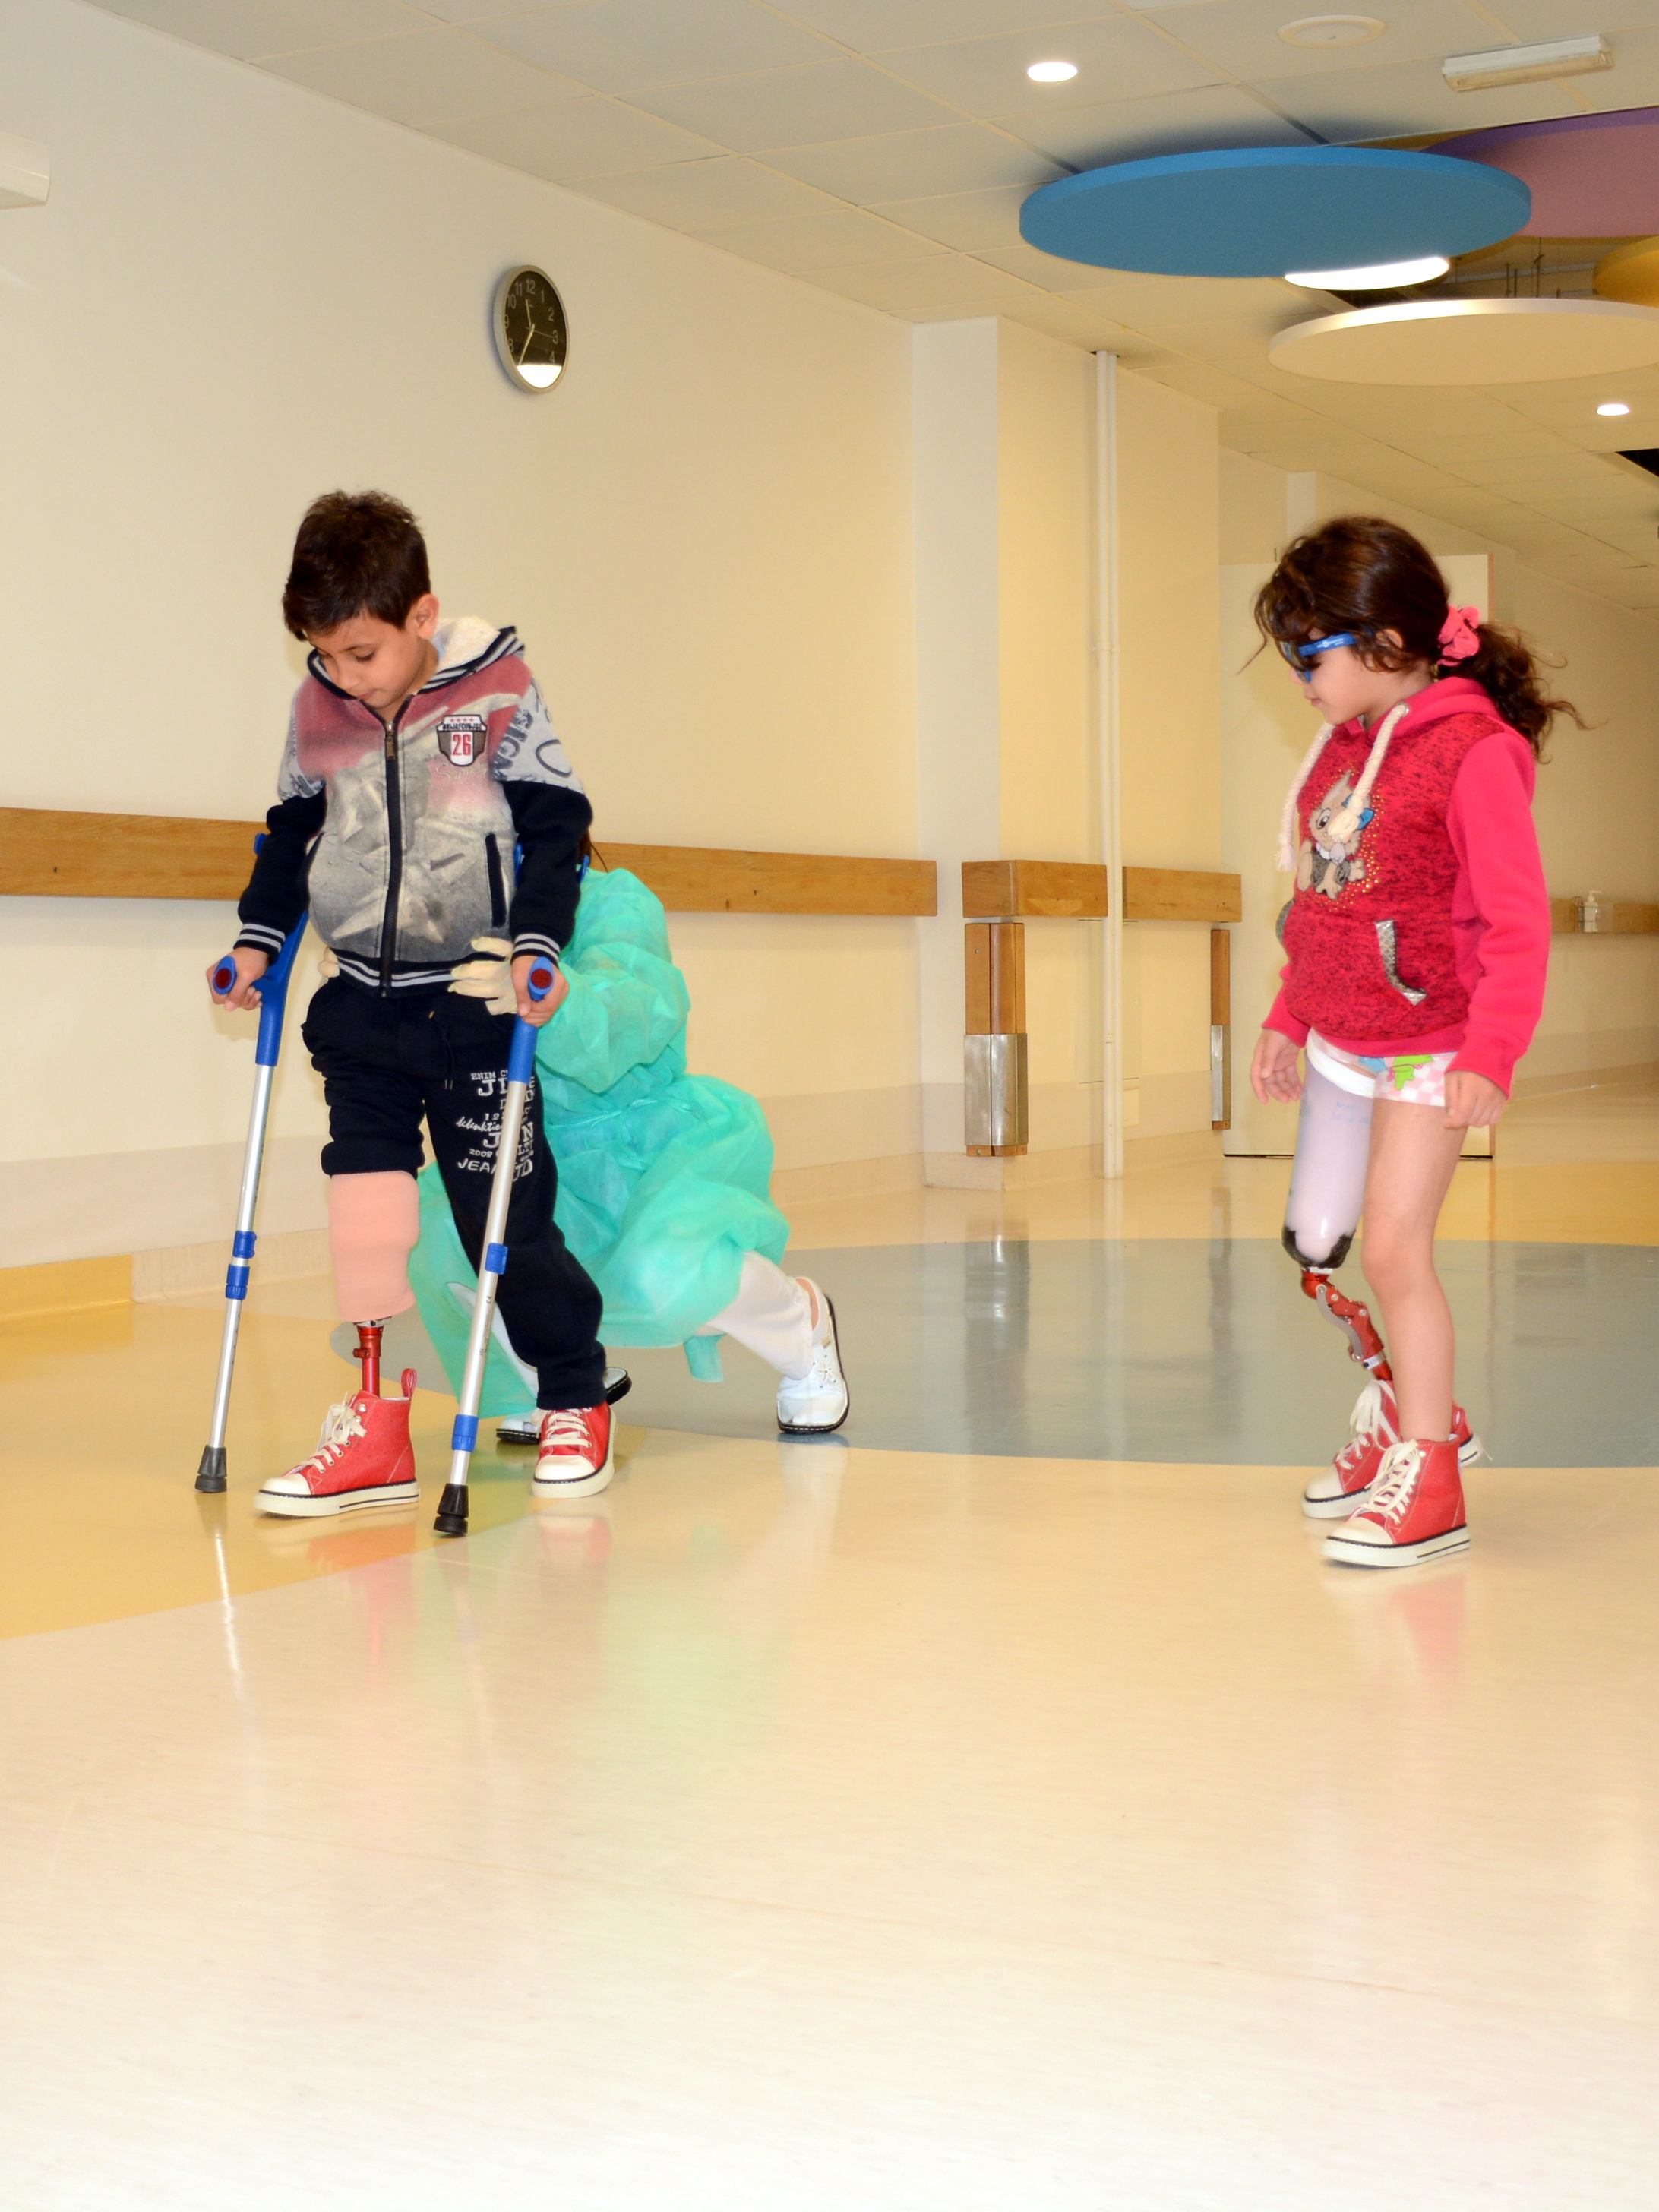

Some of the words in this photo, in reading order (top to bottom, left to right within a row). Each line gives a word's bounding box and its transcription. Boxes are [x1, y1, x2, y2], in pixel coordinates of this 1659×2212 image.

[515, 281, 523, 297] 11
[526, 279, 536, 295] 12
[507, 294, 517, 309] 10
[541, 290, 545, 303] 1
[548, 307, 555, 322] 2
[552, 330, 559, 345] 3
[508, 338, 514, 353] 8
[452, 734, 472, 756] 26
